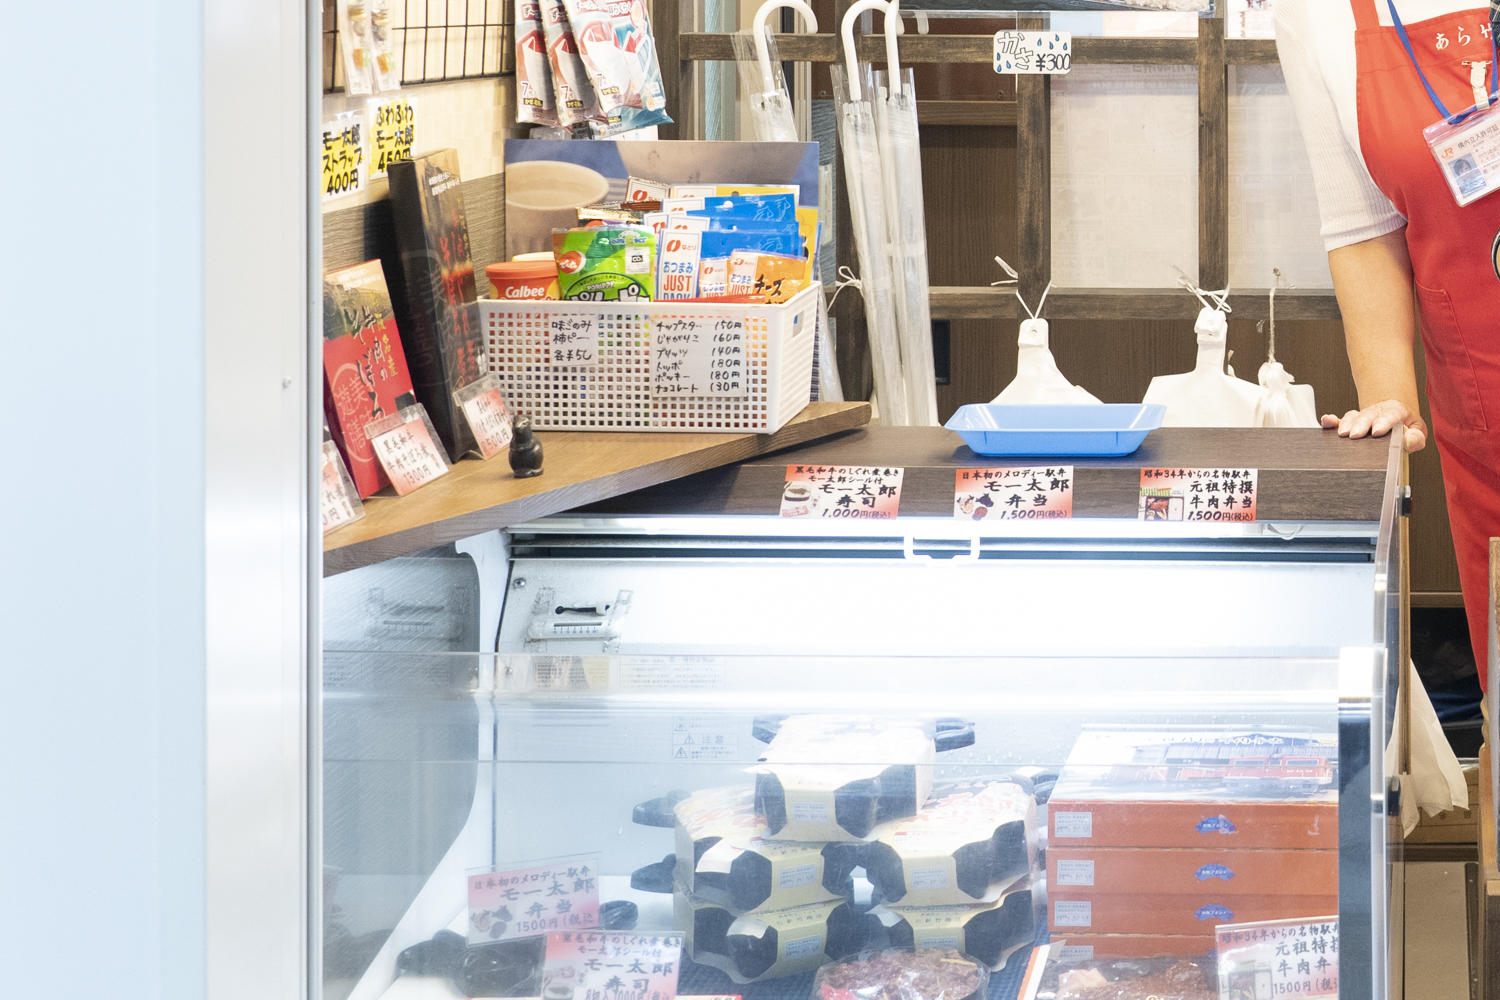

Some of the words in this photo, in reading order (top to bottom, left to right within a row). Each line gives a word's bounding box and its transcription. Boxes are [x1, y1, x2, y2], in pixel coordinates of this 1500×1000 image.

[1035, 52, 1072, 72] ¥300
[326, 168, 359, 196] 400円
[662, 260, 695, 274] おつまみ
[663, 275, 693, 292] JUST
[505, 285, 545, 299] Calbee
[551, 318, 593, 332] 味ごのみ
[714, 319, 742, 330] 150円
[553, 332, 591, 345] 柿ピー
[713, 332, 742, 344] 160円
[711, 346, 742, 358] 140円
[711, 358, 741, 370] 180円
[709, 370, 741, 382] 180円
[962, 468, 1068, 480] 日本初のメロディー駅弁
[1144, 468, 1251, 480] 昭和34年からの名物駅弁
[819, 483, 897, 498] モー太郎
[985, 477, 1070, 493] モー太郎
[836, 495, 877, 509] 寿司
[1006, 493, 1049, 508] 弁当
[1190, 494, 1254, 509] 牛肉弁当
[500, 876, 595, 901] モー太郎
[525, 899, 573, 918] 弁当
[584, 957, 674, 978] モー太郎
[603, 975, 650, 994] 寿司
